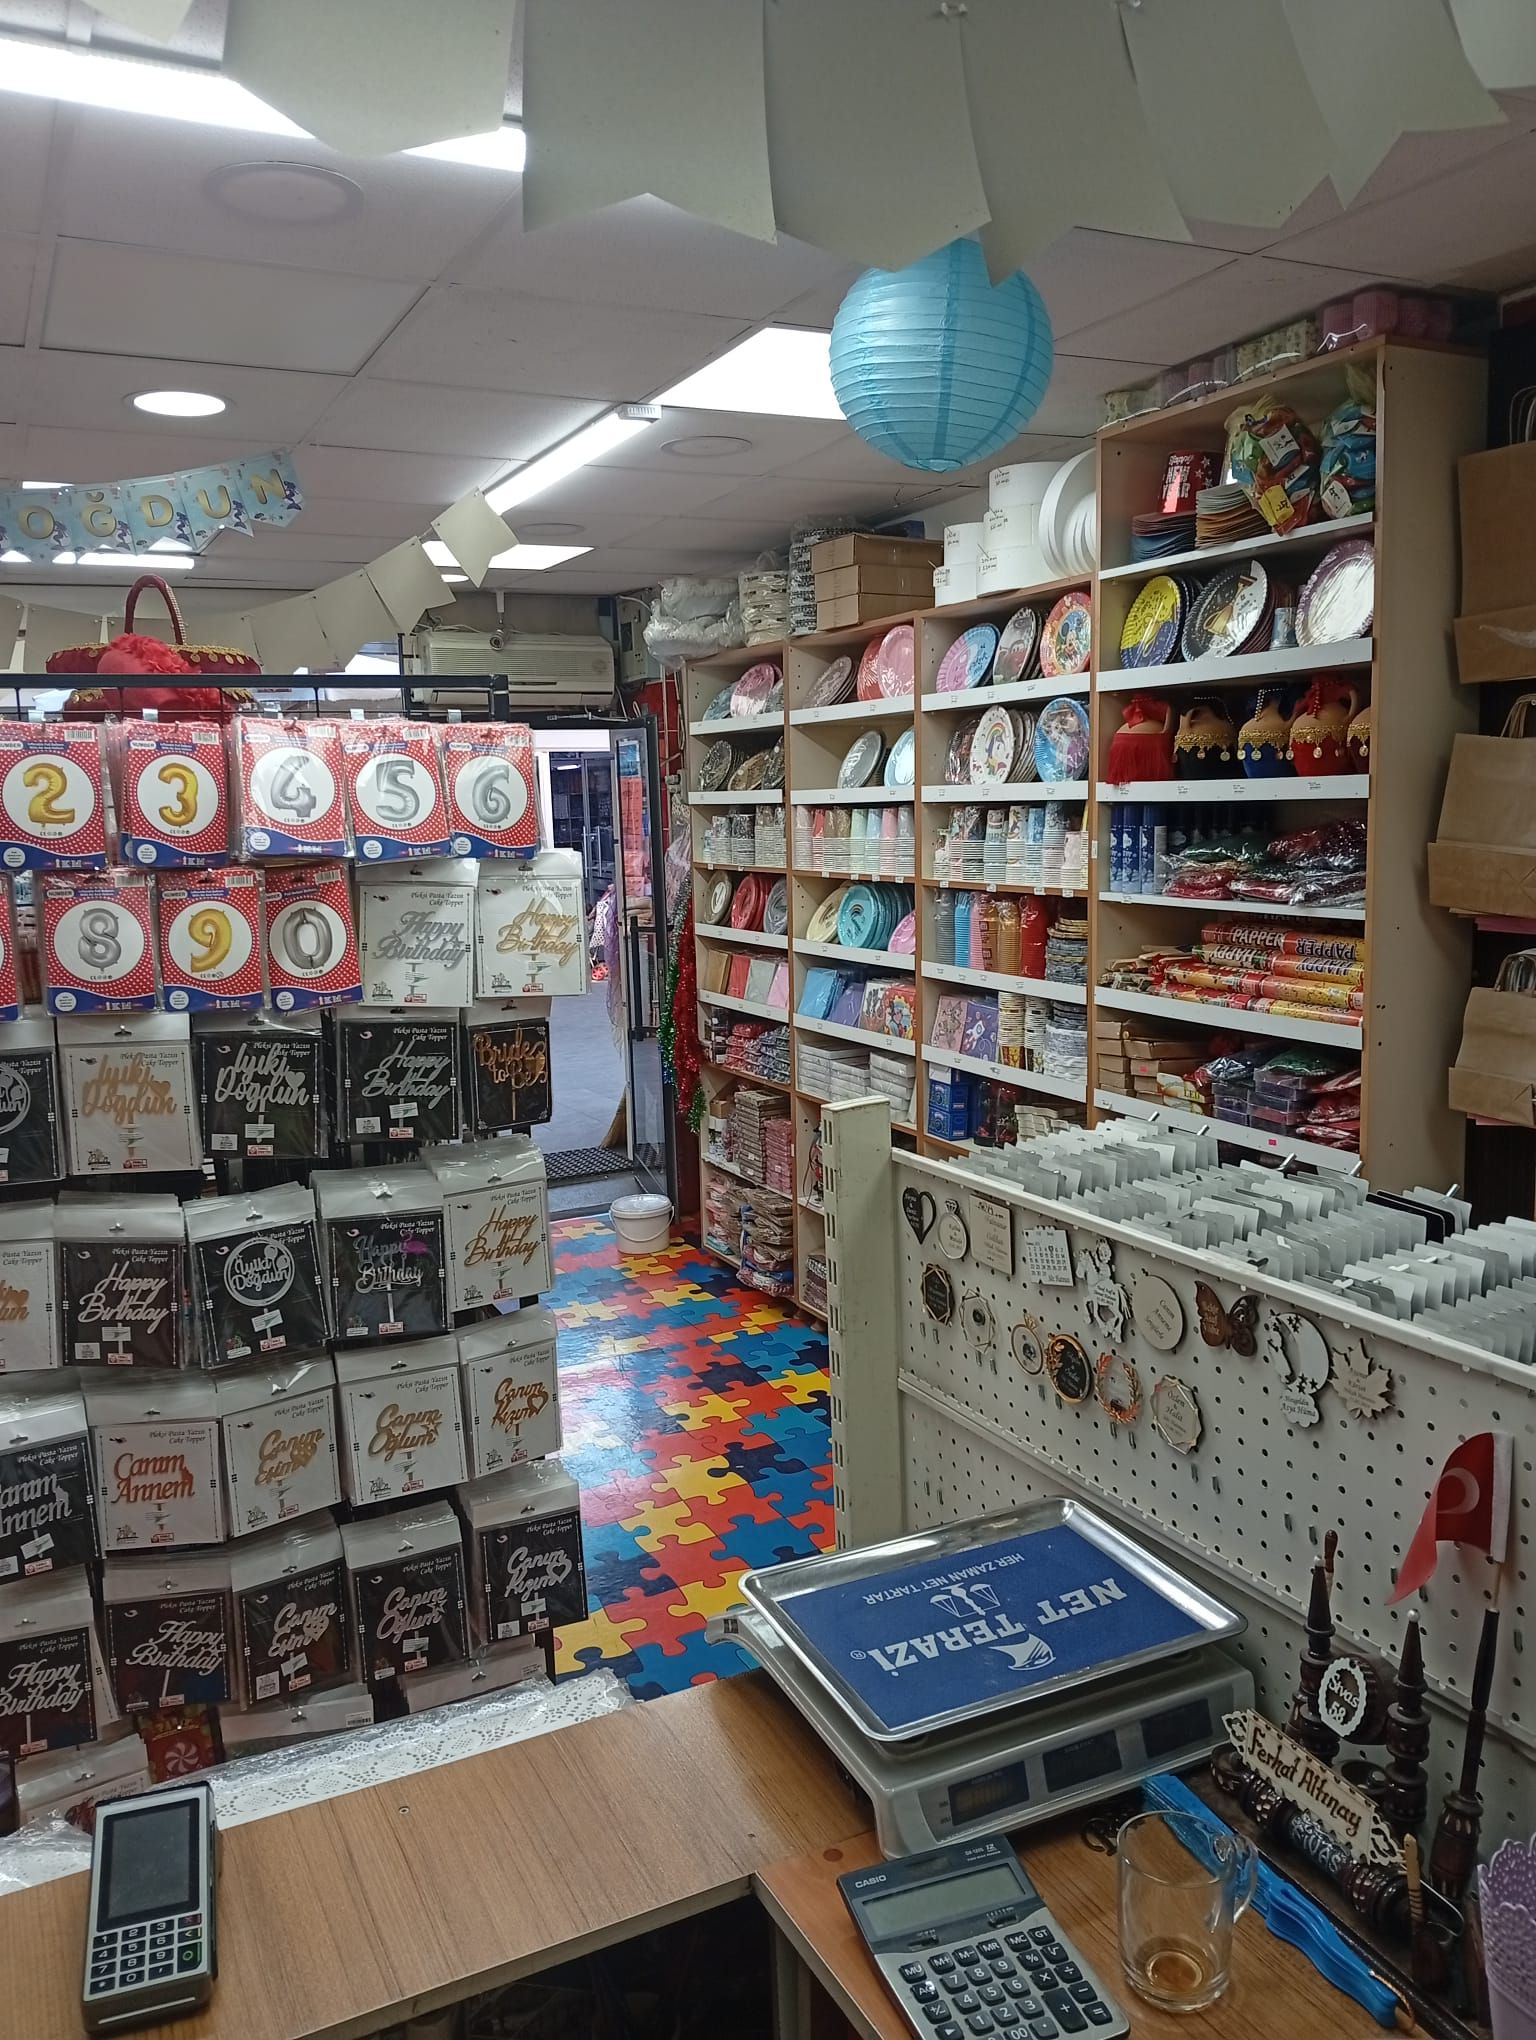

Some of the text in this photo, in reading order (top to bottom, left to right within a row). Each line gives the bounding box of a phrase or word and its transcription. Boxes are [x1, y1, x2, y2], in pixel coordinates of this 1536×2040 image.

[23, 763, 75, 825] 2
[158, 763, 198, 826] 3
[270, 755, 316, 817] 4
[376, 760, 420, 823] 5
[472, 765, 511, 823] 6
[393, 910, 464, 942] Happy
[513, 897, 578, 939] Happy
[78, 908, 122, 970] 8
[188, 908, 232, 972] 9
[283, 907, 332, 969] 0
[372, 930, 465, 970] Birthday
[496, 924, 579, 967] Birthday
[1210, 946, 1254, 962] HAPPY
[1233, 929, 1284, 949] PAPPER
[1296, 938, 1355, 960] PAPPER
[379, 1039, 451, 1081] Happy
[361, 1067, 451, 1109] Birthday
[483, 1205, 538, 1240] Happy
[464, 1232, 539, 1267] Birthday
[94, 1261, 168, 1305] Happy
[354, 1262, 423, 1293] Birthday
[78, 1292, 170, 1334] Birthday
[495, 1377, 545, 1403] Canım
[376, 1403, 442, 1434] Canım
[114, 1453, 187, 1481] Canım
[0, 1473, 58, 1510] anım
[111, 1474, 195, 1504] Annem
[506, 1546, 566, 1576] Canım
[862, 1552, 1025, 1605] HER ZAMAN NET TARTAR
[383, 1586, 448, 1617] Canım
[1037, 1578, 1128, 1625] NET
[148, 1620, 224, 1652] Happy
[0, 1658, 81, 1691] Happy
[125, 1643, 224, 1675] Birthday
[1328, 1673, 1360, 1708] Sivas
[1328, 1702, 1347, 1723] 58
[1248, 1725, 1363, 1837] Ferhat Altınay
[855, 1875, 887, 1888] CASIO
[98, 1936, 166, 1958] 4 5 6
[101, 1922, 166, 1943] 1 2 3
[98, 1951, 166, 1973] 7 8 9
[905, 1965, 922, 1976] MU
[934, 1957, 950, 1967] M+
[983, 1942, 999, 1952] MR
[1010, 1934, 1027, 1945] MC
[1034, 1930, 1048, 1939] GT
[949, 1975, 959, 1985] 7
[974, 1968, 985, 1978] 8
[999, 1960, 1009, 1970] 9
[963, 1994, 973, 2004] 4
[988, 1987, 998, 1997] 5
[1011, 1979, 1022, 1990] 6
[976, 2015, 985, 2025] 1
[1000, 2007, 1011, 2018] 2
[1026, 2000, 1037, 2010] 3
[1010, 2027, 1028, 2039] 00
